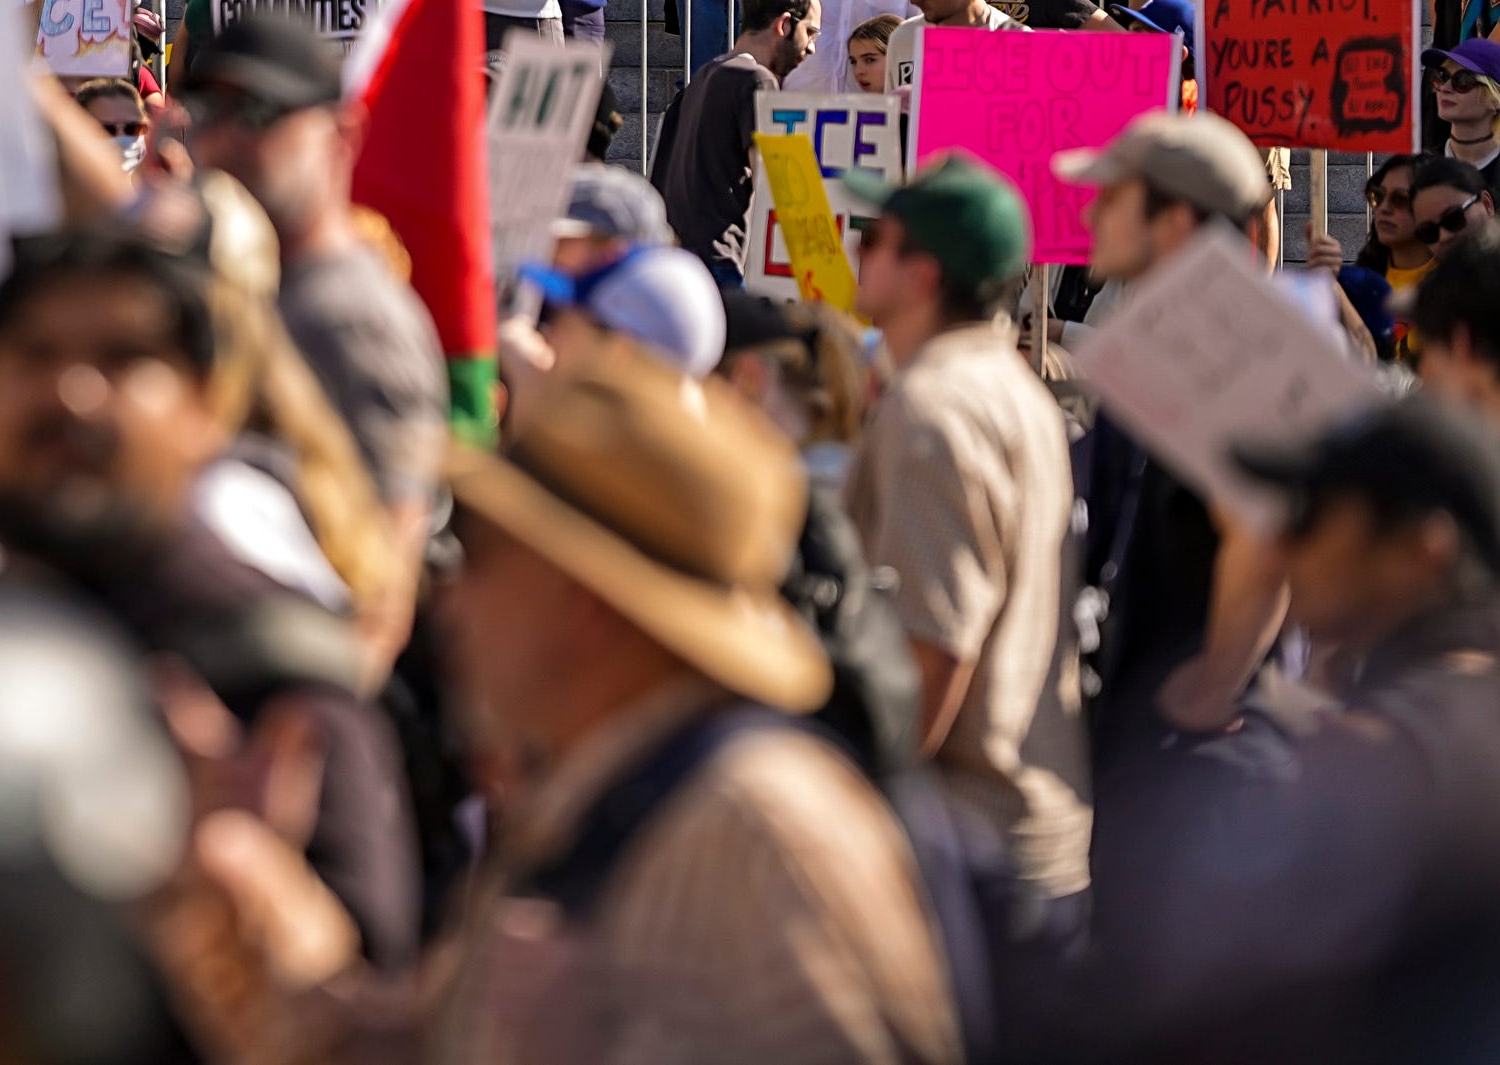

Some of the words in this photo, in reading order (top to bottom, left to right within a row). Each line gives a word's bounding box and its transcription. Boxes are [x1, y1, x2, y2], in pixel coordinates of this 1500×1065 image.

[925, 35, 1032, 95] ICE
[1046, 34, 1166, 96] OUT
[1210, 37, 1295, 77] YOU'RE
[1311, 38, 1330, 67] A
[986, 96, 1087, 156] FOR
[1223, 81, 1316, 138] PUSSY.
